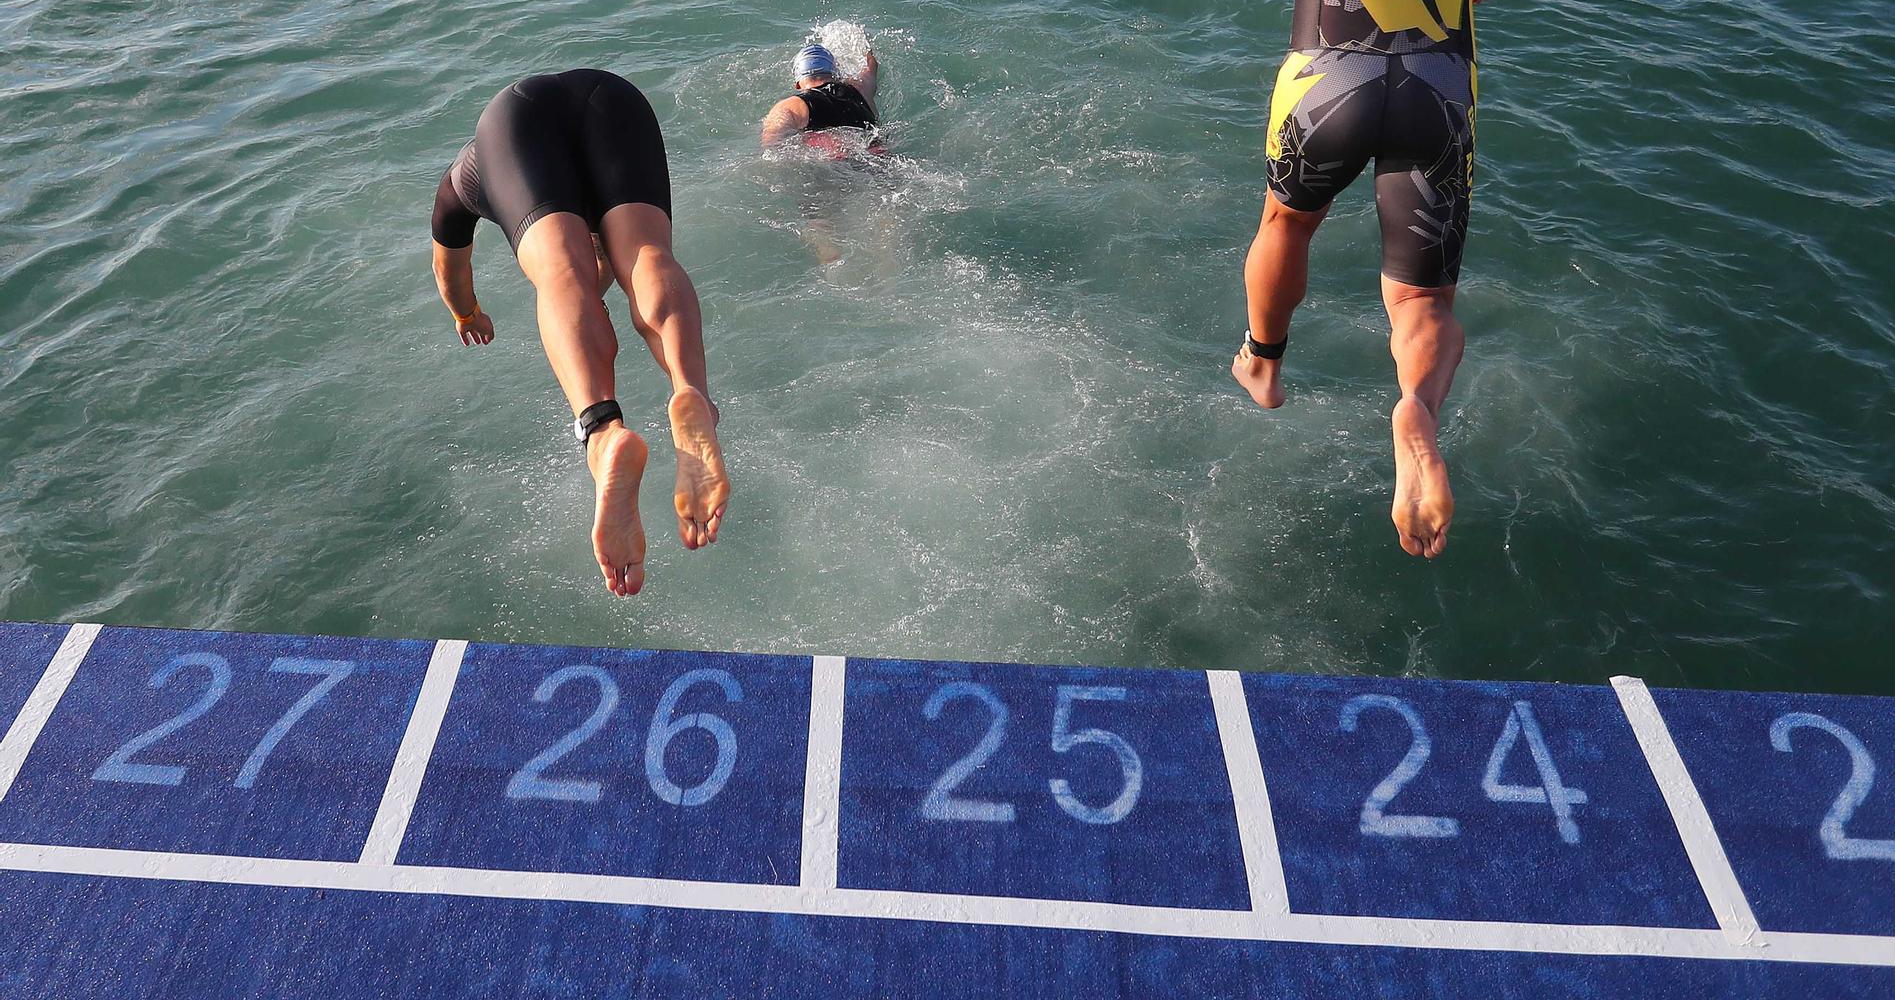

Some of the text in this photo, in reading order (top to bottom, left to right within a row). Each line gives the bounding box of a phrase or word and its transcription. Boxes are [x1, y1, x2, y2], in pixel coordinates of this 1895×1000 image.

[92, 652, 357, 790] 27
[504, 665, 746, 807] 26
[919, 681, 1144, 826] 25
[1338, 694, 1588, 844] 24
